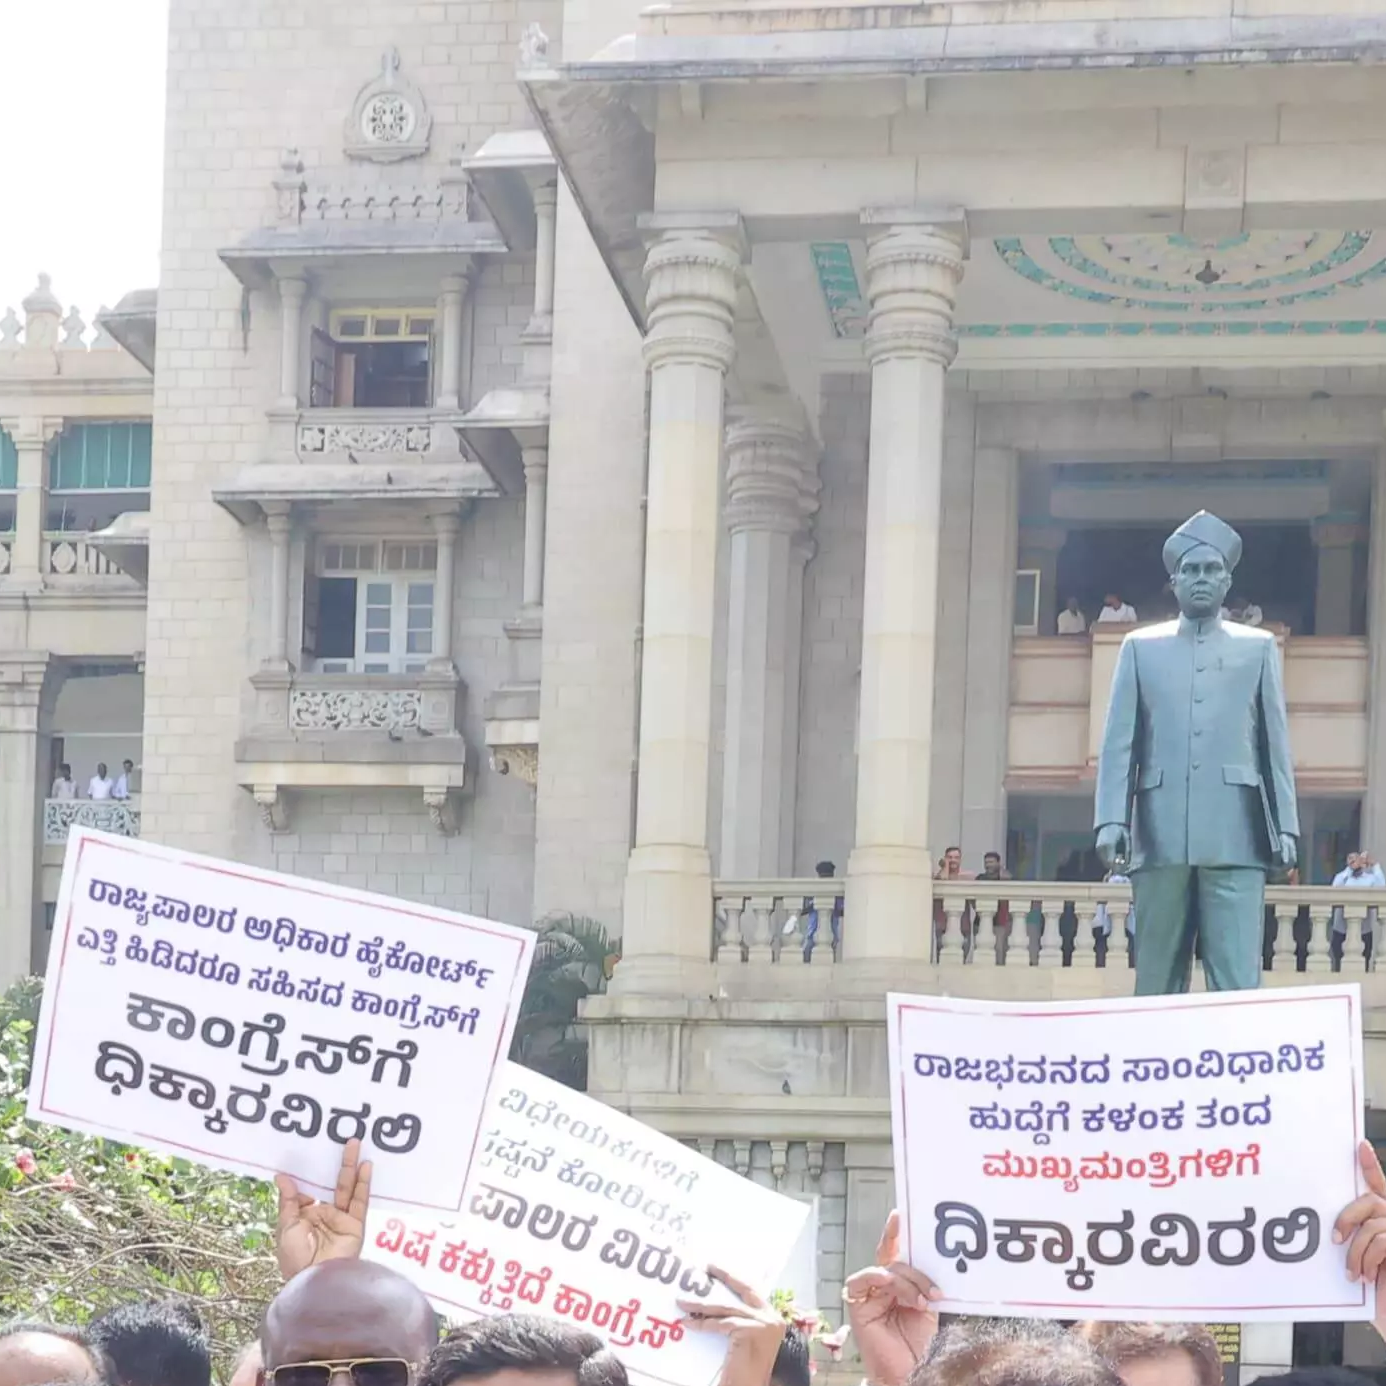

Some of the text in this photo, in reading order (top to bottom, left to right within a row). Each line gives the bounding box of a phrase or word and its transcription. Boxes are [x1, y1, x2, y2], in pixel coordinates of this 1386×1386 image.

[78, 928, 117, 965] ಎತ್ತಿ
[126, 936, 240, 985] ಹಿಡಿದರೂ
[248, 967, 344, 1007] ಸಹಿಸದ
[89, 879, 493, 988] ರಾಜ್ಯಪಾಲರ ಅಧಿಕಾರ ಹೈಕೋರ್ಟ್
[95, 1041, 421, 1156] ಧಿಕ್ಕಾರವಿರಲಿ
[914, 1041, 1324, 1089] ರಾಜಭವನದ ಸಾಂವಿಧಾನಿಕ
[970, 1095, 1271, 1144] ಹುದ್ದೆಗೆ ಕಳಂಕ ತಂದ
[983, 1141, 1260, 1192] ಮುಖ್ಯಮಂತ್ರಿಗಳಿಗೆ
[933, 1202, 1320, 1291] ಧಿಕ್ಕಾರವಿರಲಿ
[553, 1282, 686, 1350] ಕಾಂಗ್ರೆಸ್
